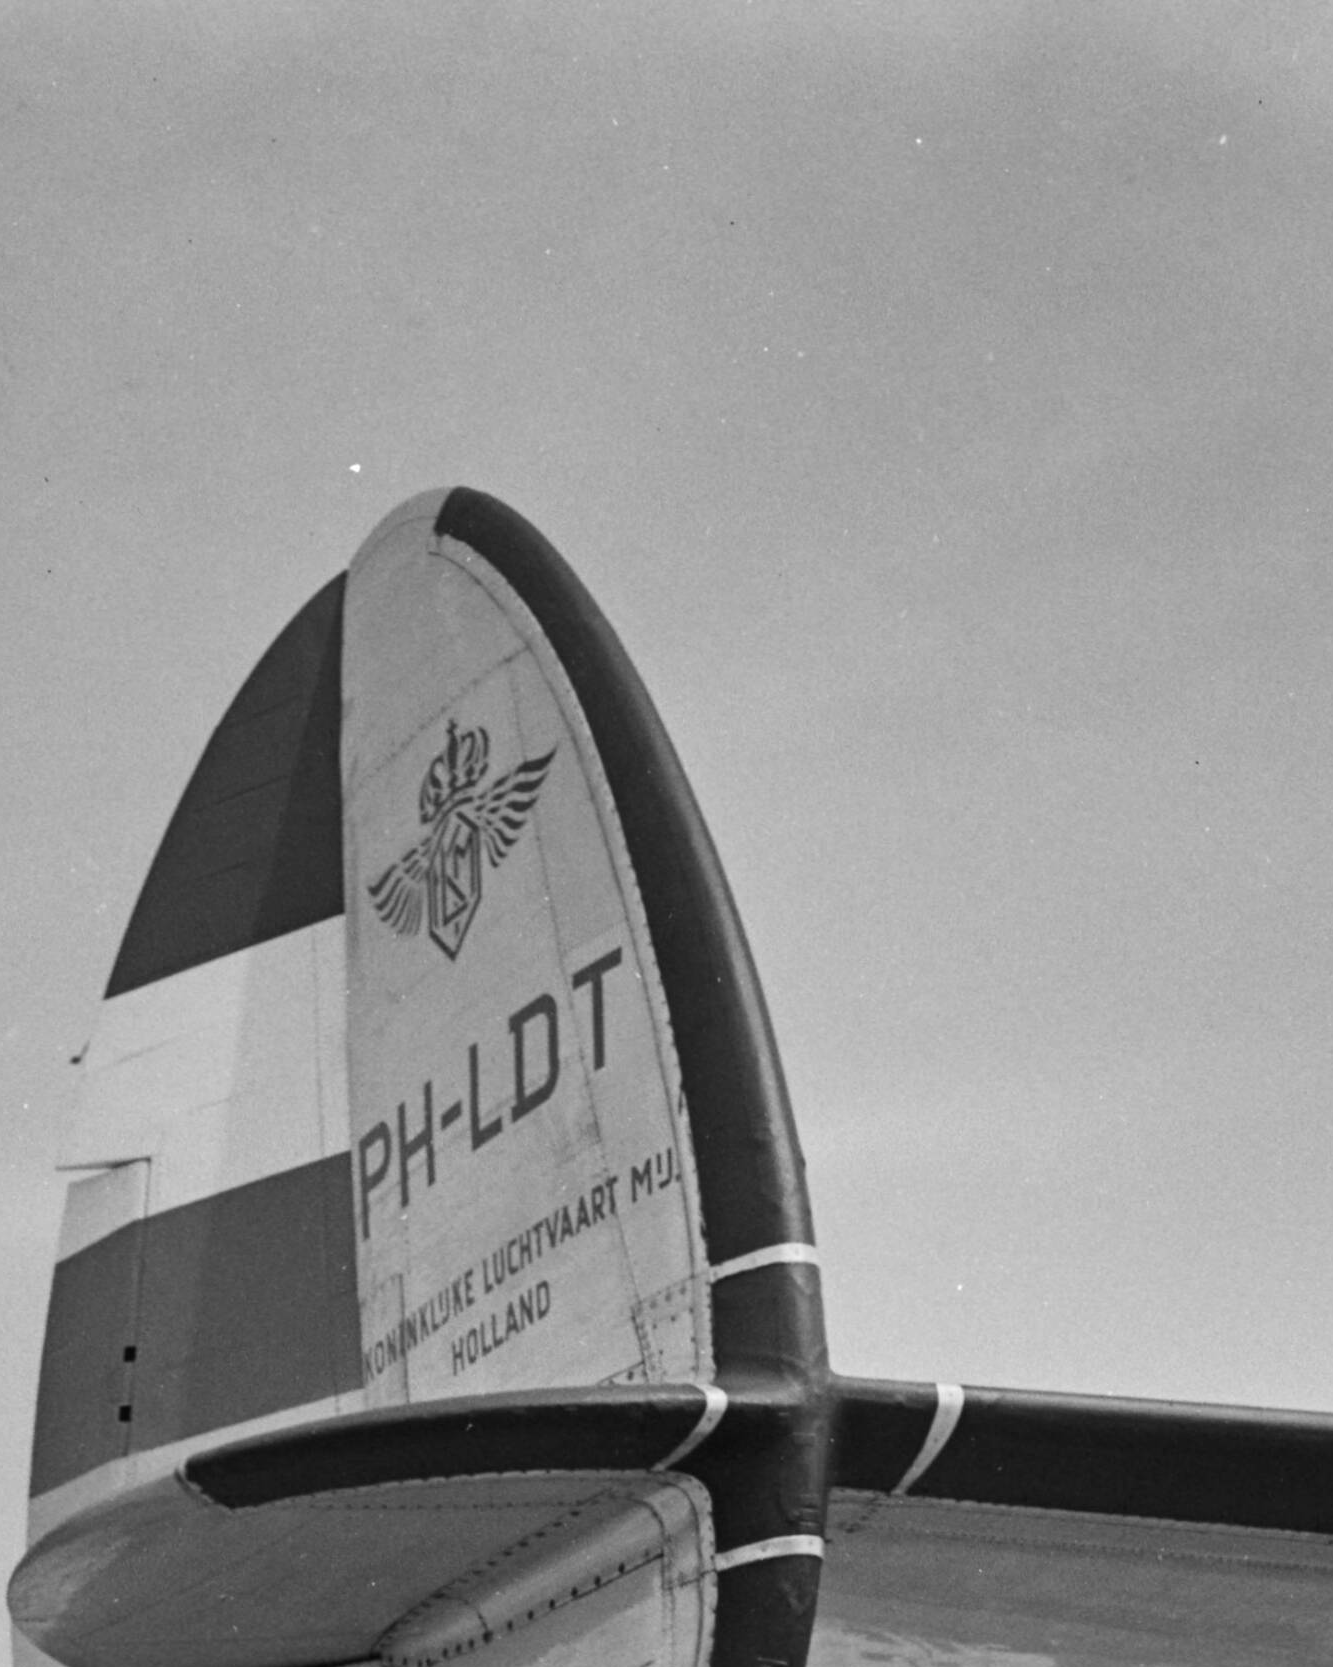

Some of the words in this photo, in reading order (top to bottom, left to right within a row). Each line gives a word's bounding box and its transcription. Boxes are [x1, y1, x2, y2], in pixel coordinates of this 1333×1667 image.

[357, 948, 623, 1241] PH-LDT
[482, 1175, 619, 1295] LUCHTVAART
[451, 1280, 551, 1376] HOLLAND
